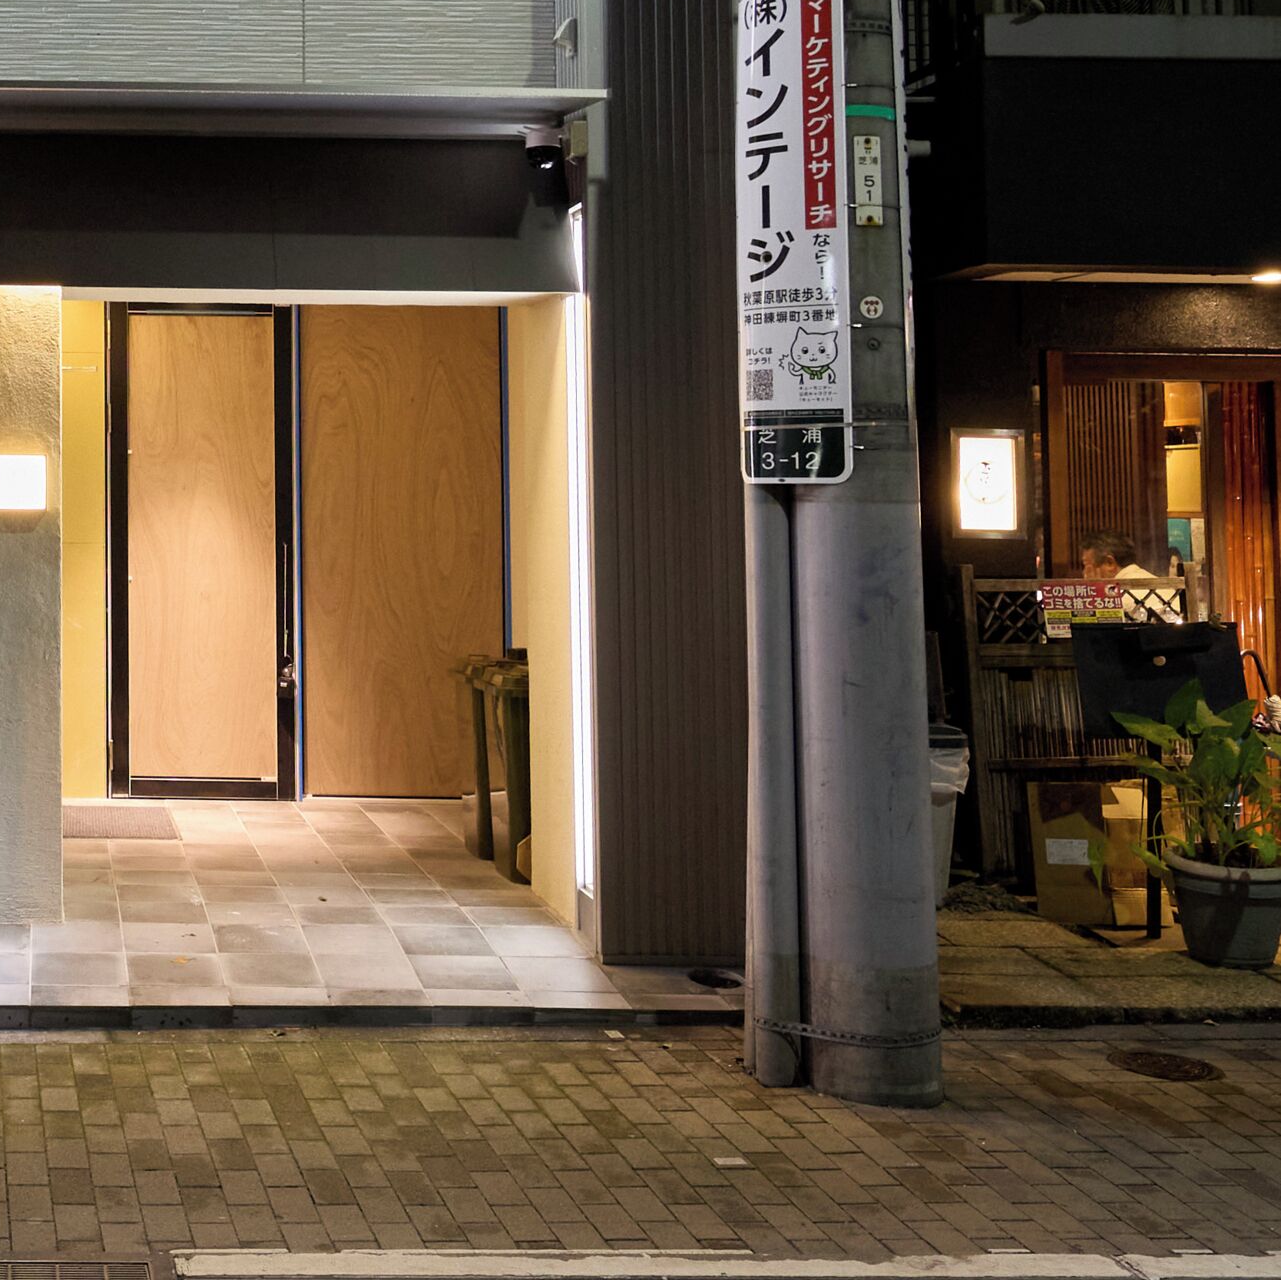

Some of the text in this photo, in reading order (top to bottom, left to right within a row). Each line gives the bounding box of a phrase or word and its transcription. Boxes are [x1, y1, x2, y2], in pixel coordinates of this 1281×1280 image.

[761, 451, 820, 470] 3-12
[1042, 585, 1097, 598] この場所に
